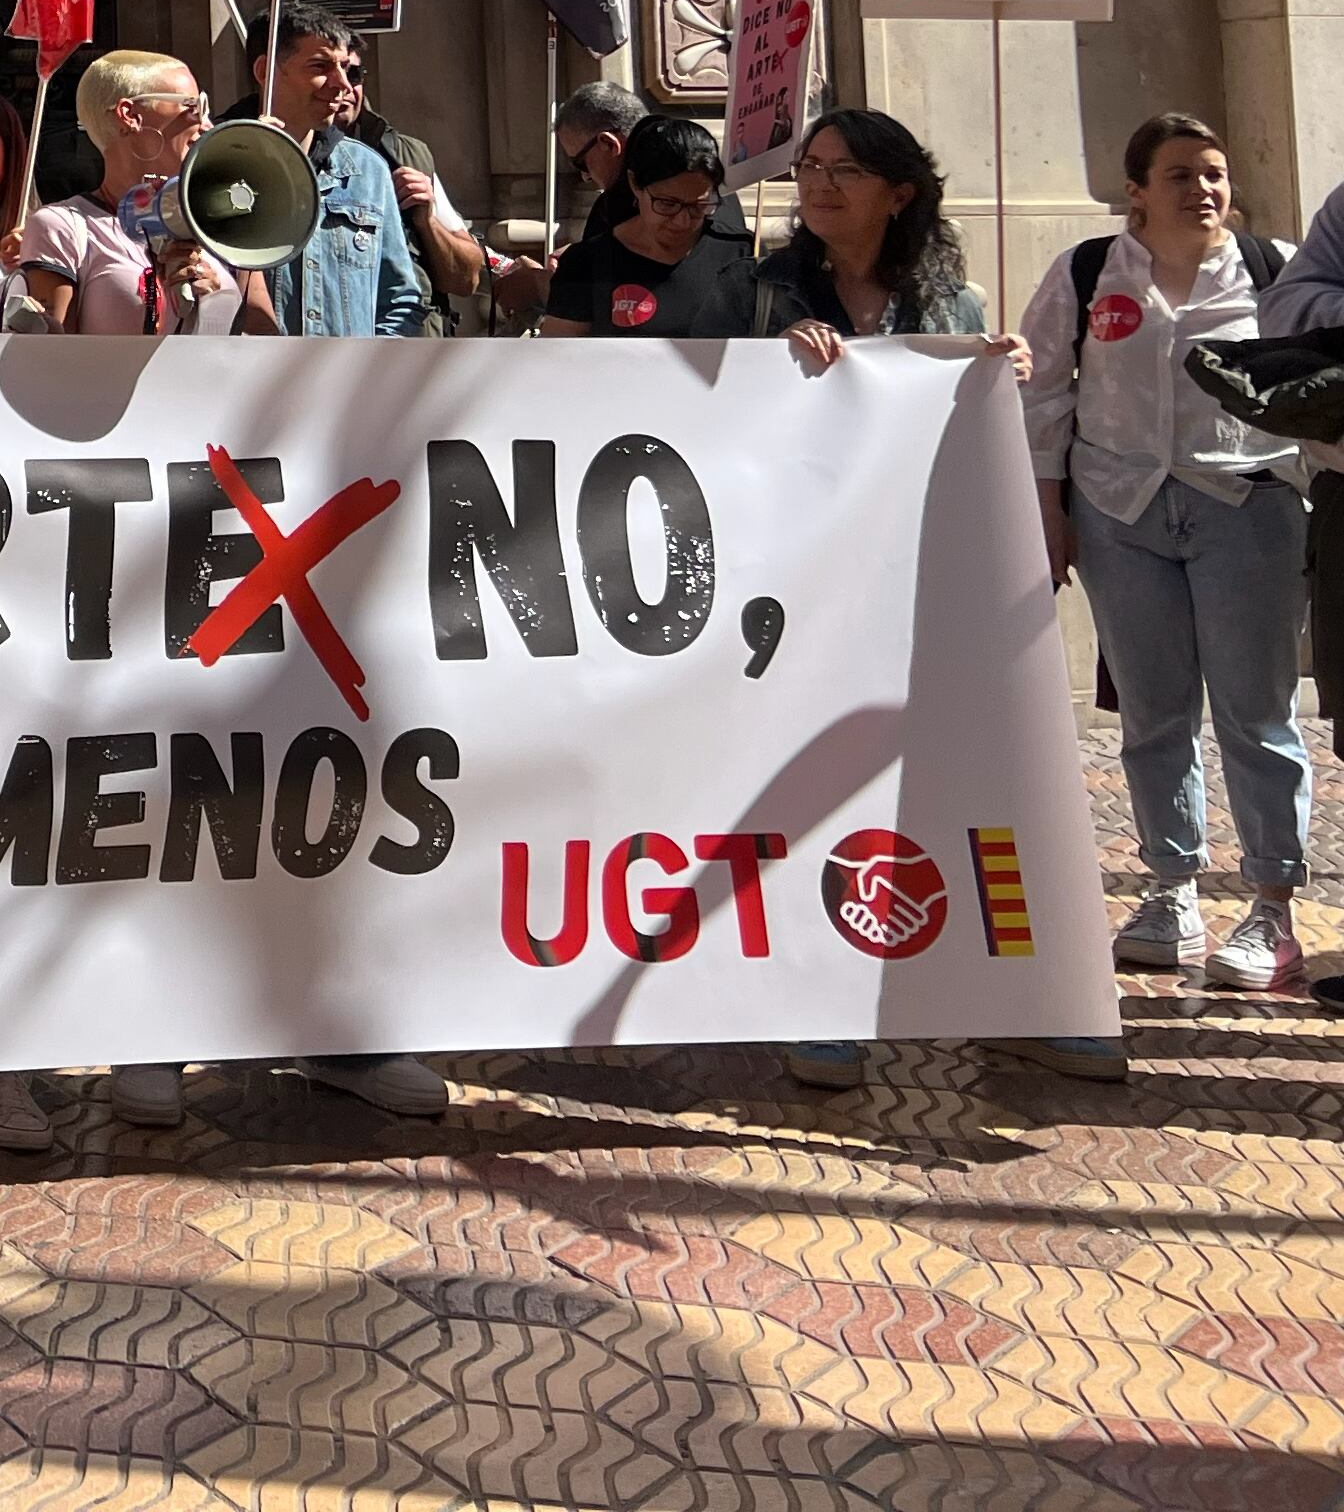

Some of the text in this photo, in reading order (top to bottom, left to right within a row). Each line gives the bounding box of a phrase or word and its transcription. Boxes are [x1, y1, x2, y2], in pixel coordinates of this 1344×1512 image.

[743, 10, 771, 36] DICE
[754, 36, 769, 54] AL
[746, 52, 779, 83] ARTE
[427, 433, 789, 681] NO,
[499, 833, 789, 968] UGT
